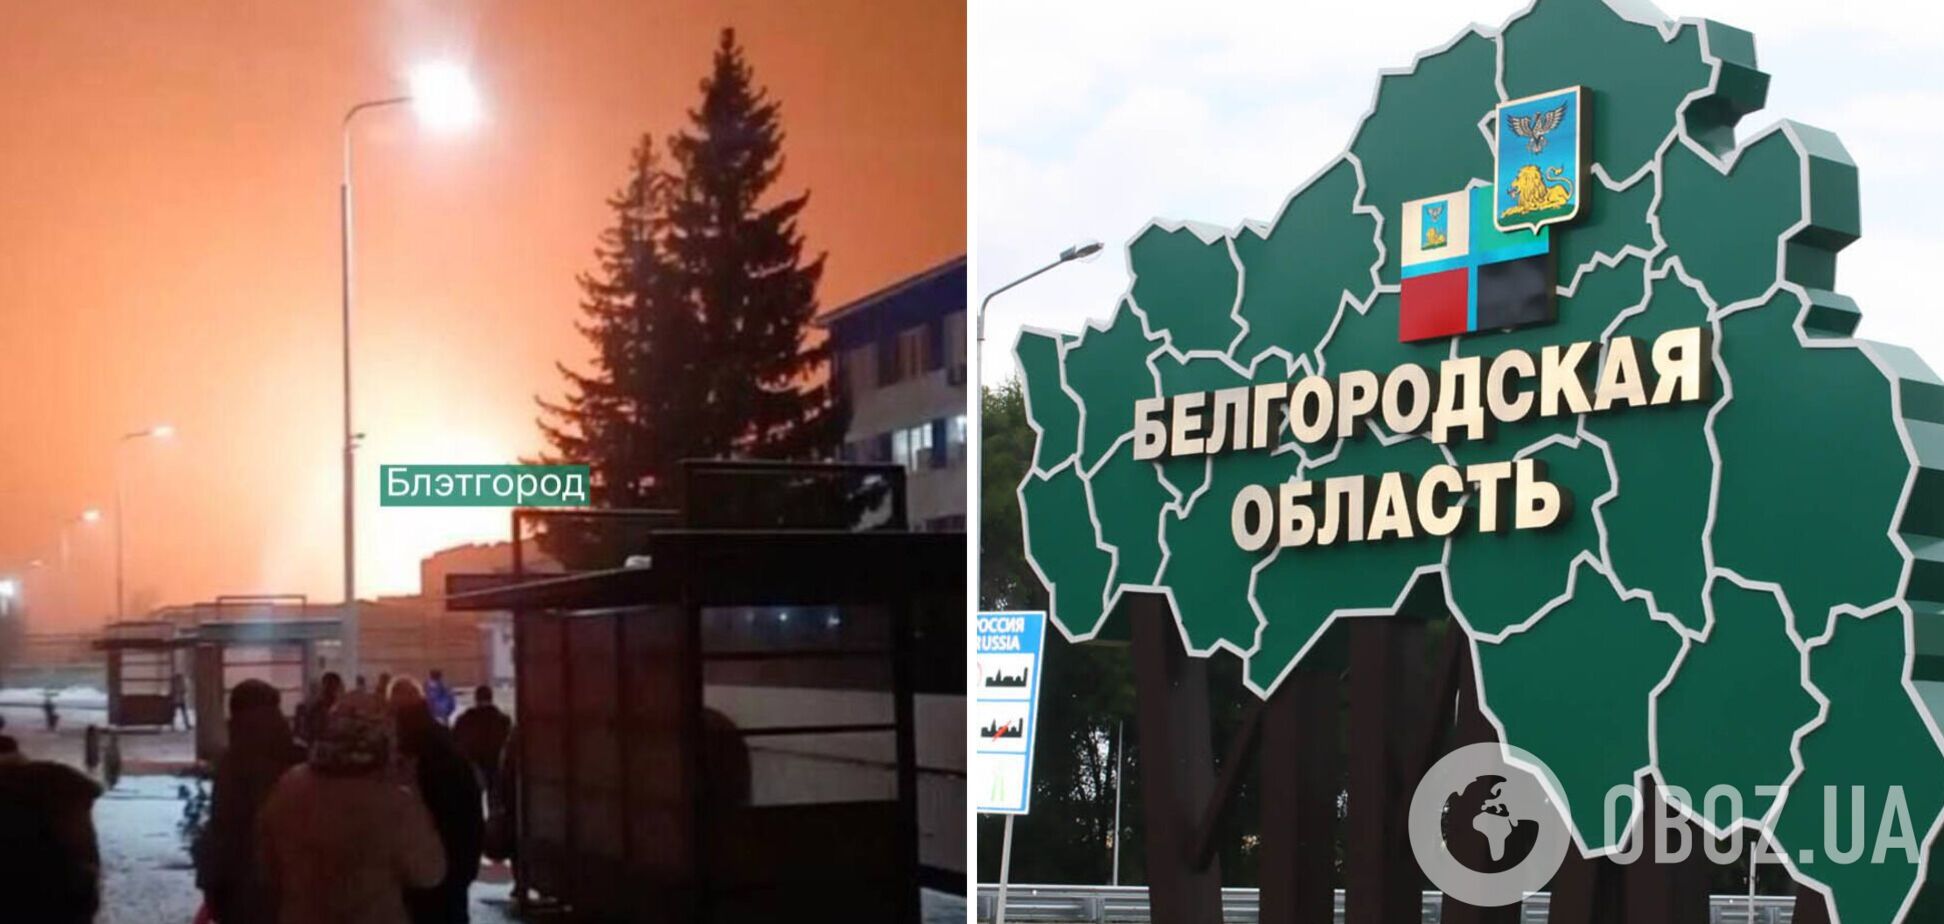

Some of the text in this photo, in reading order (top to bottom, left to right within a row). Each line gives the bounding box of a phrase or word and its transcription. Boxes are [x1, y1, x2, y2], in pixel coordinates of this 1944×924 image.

[1133, 326, 1703, 461] БЕЛГОРОДСКАЯ
[1231, 457, 1564, 552] ОБЛАСТЬ
[977, 616, 1025, 633] ОССИЯ
